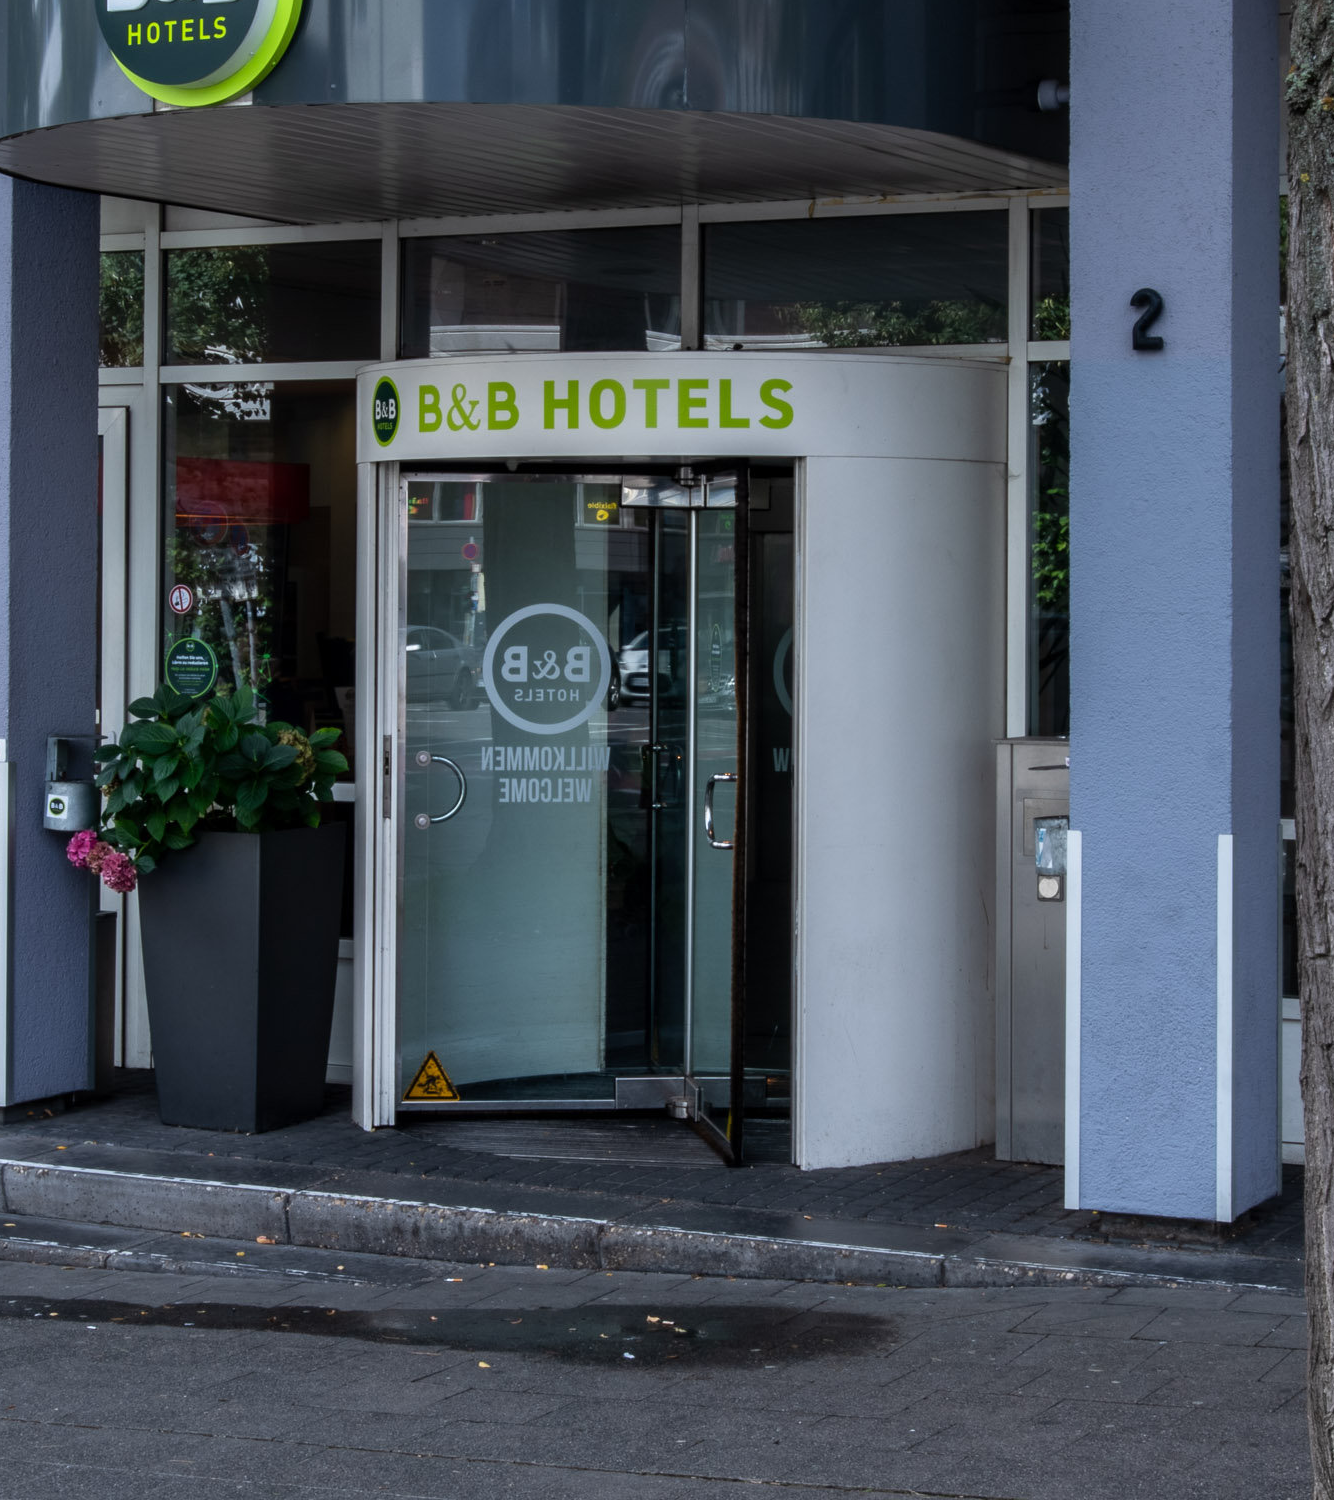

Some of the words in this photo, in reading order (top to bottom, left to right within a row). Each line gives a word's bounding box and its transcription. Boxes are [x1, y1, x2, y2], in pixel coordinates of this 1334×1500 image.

[127, 16, 227, 46] HOTELS
[1130, 288, 1164, 350] 2
[375, 398, 396, 420] B&B
[419, 381, 520, 433] B&B
[543, 378, 795, 430] HOTELS
[377, 422, 393, 430] HOTELS
